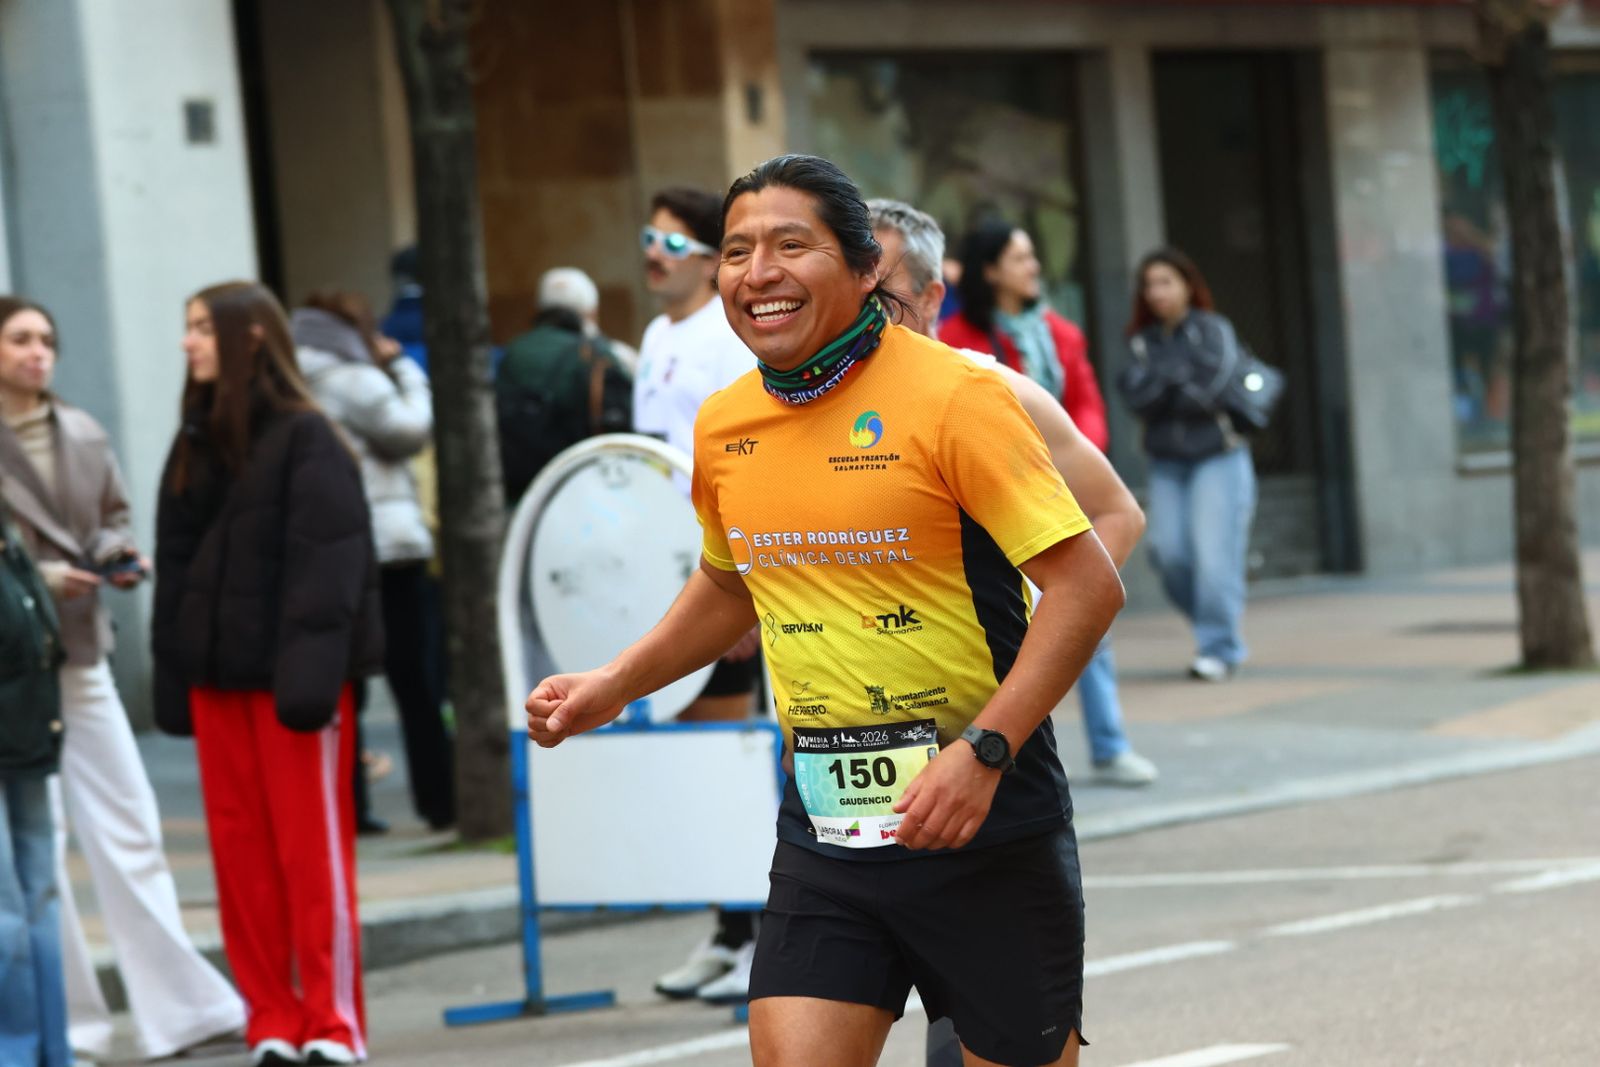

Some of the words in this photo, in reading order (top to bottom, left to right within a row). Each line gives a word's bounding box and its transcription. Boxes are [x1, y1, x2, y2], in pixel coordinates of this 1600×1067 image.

[725, 438, 759, 456] EKT
[828, 455, 859, 464] ESCUELA
[860, 453, 900, 463] TRIATLÓN
[834, 463, 887, 472] SALMANTINA
[753, 532, 803, 547] ESTER
[807, 527, 910, 545] RODRÍGUEZ
[758, 549, 831, 568] CLÍNICA
[835, 548, 914, 565] DENTAL
[876, 625, 923, 635] Salamanca
[890, 686, 946, 703] Ayuntamiento
[905, 698, 949, 711] Salamanca
[860, 730, 889, 743] 2026
[829, 756, 897, 789] 150
[839, 795, 892, 806] GAUDENCIO
